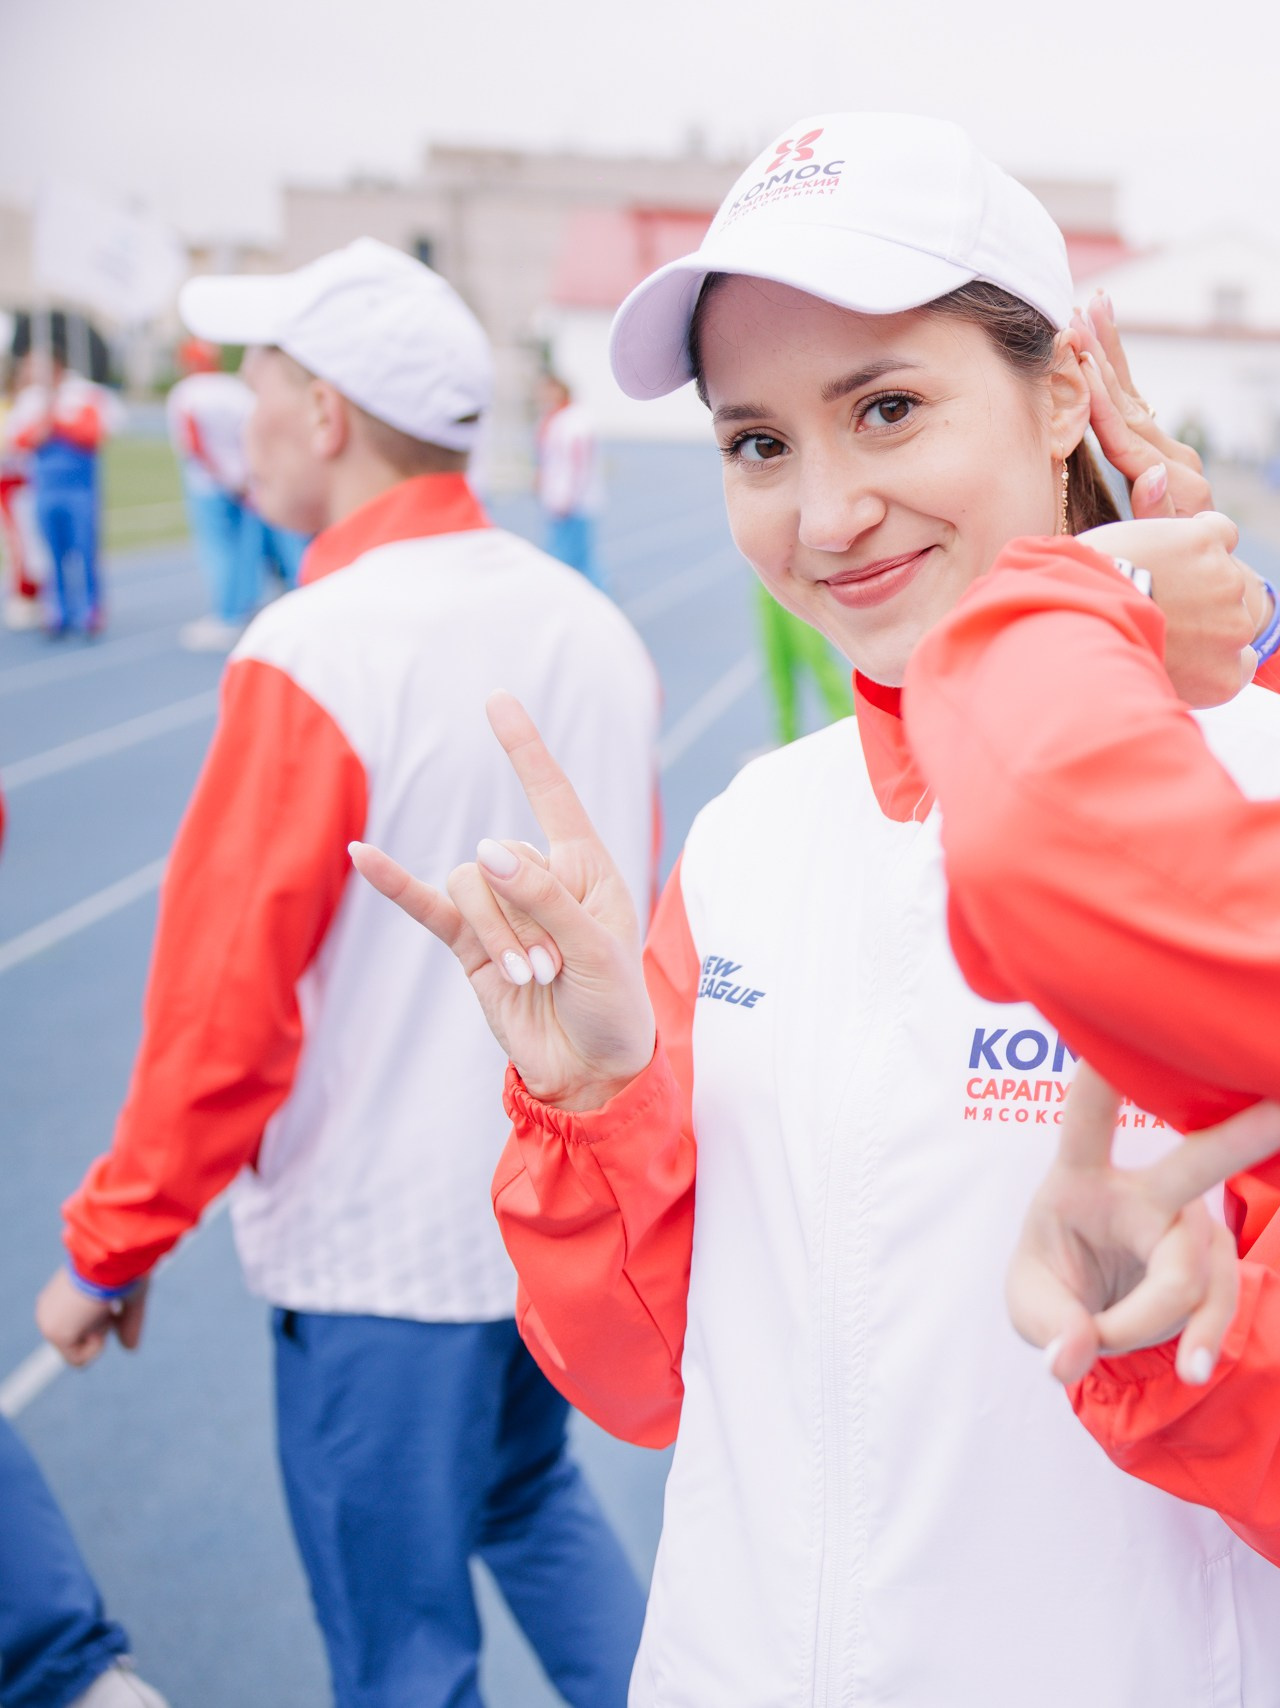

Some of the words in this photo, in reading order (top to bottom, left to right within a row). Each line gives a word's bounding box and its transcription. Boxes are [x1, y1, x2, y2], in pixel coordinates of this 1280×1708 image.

[728, 160, 845, 215] КОМОС
[730, 176, 840, 217] АРАПУЛЬСКИЙ
[702, 955, 743, 977] EW
